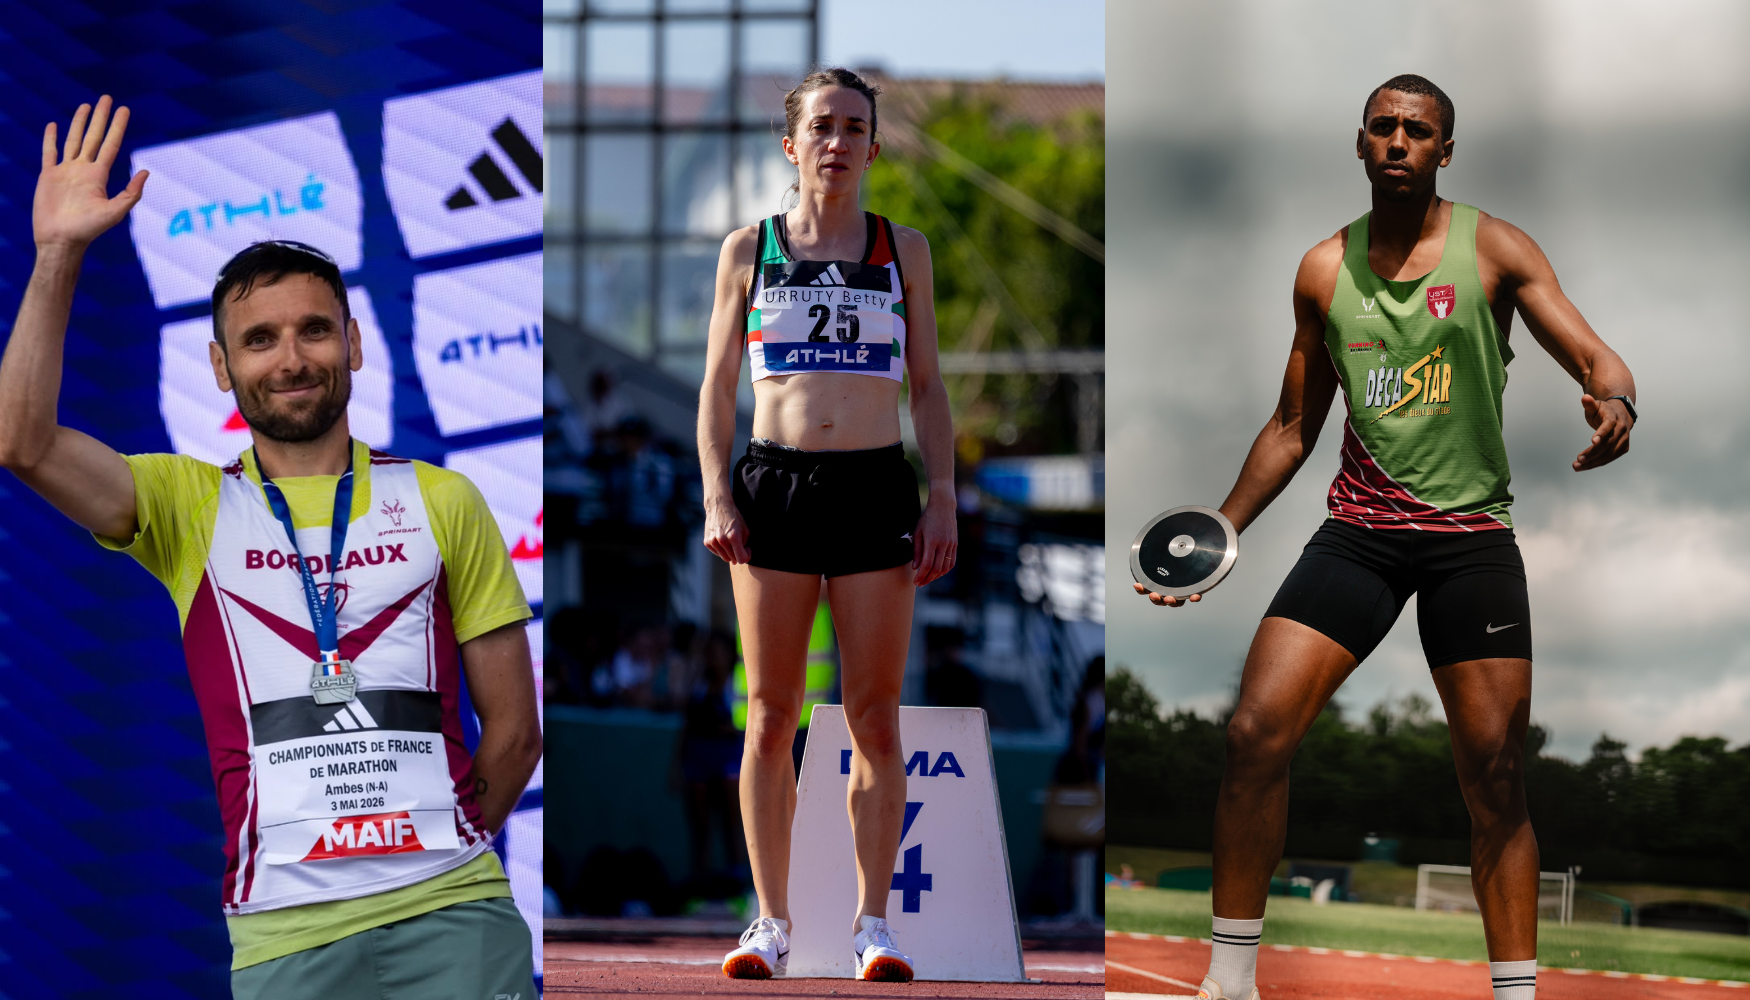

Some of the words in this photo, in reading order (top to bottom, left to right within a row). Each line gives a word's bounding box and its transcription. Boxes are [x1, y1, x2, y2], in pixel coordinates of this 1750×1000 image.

[169, 173, 324, 236] ATHLÉ
[765, 290, 834, 303] URRUTY
[843, 290, 887, 309] Betty
[807, 303, 860, 344] 25
[785, 344, 870, 363] ATHLÉ
[1399, 409, 1408, 418] les
[1410, 407, 1425, 418] dieux
[1427, 407, 1434, 416] du
[378, 527, 422, 537] SPRINGART
[311, 674, 355, 688] ATHLÉ
[269, 741, 367, 765] CHAMPIONNATS
[371, 741, 384, 753] DE
[388, 739, 433, 754] FRANCE
[310, 767, 324, 778] DE
[327, 759, 398, 777] MARATHON
[841, 749, 965, 777] MA
[325, 783, 363, 796] Ambes
[366, 781, 388, 793] (N-A)
[331, 801, 338, 811] 3
[340, 799, 358, 810] MAI
[361, 797, 385, 809] 2026
[323, 818, 413, 852] MAIF
